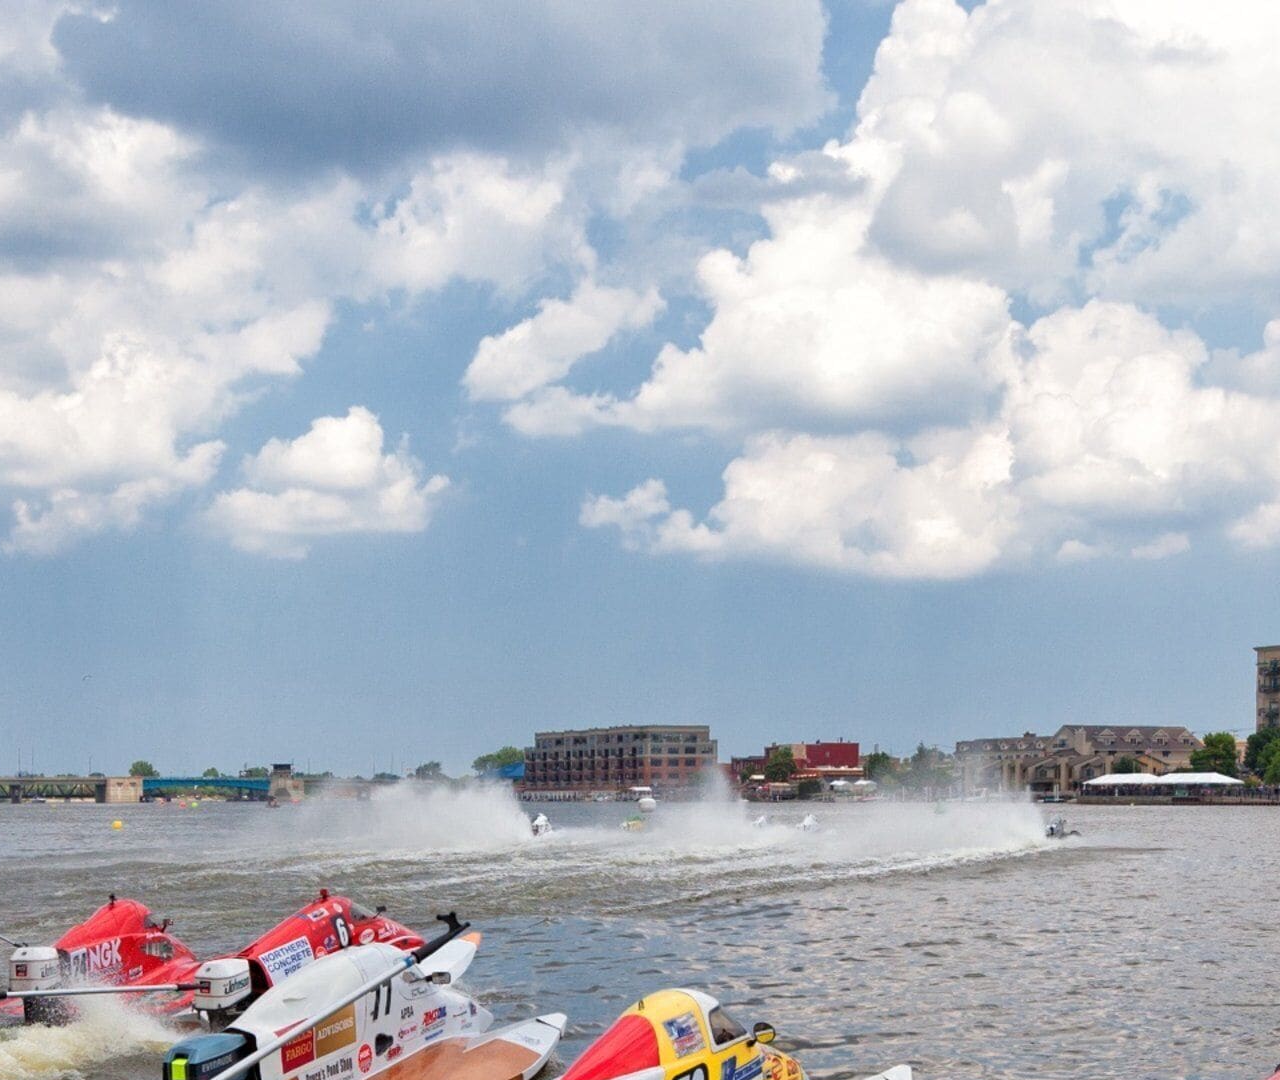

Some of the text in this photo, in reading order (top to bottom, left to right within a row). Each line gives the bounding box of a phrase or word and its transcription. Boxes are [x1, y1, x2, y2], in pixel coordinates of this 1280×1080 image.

[335, 918, 349, 947] 6
[89, 937, 121, 971] NGK
[261, 940, 308, 964] NORTHERN
[268, 948, 312, 973] CONCRETE
[224, 976, 249, 995] Johnson
[317, 1016, 354, 1040] ADVISORS
[202, 1054, 233, 1073] EVINRUDE
[285, 1041, 312, 1062] FARGO
